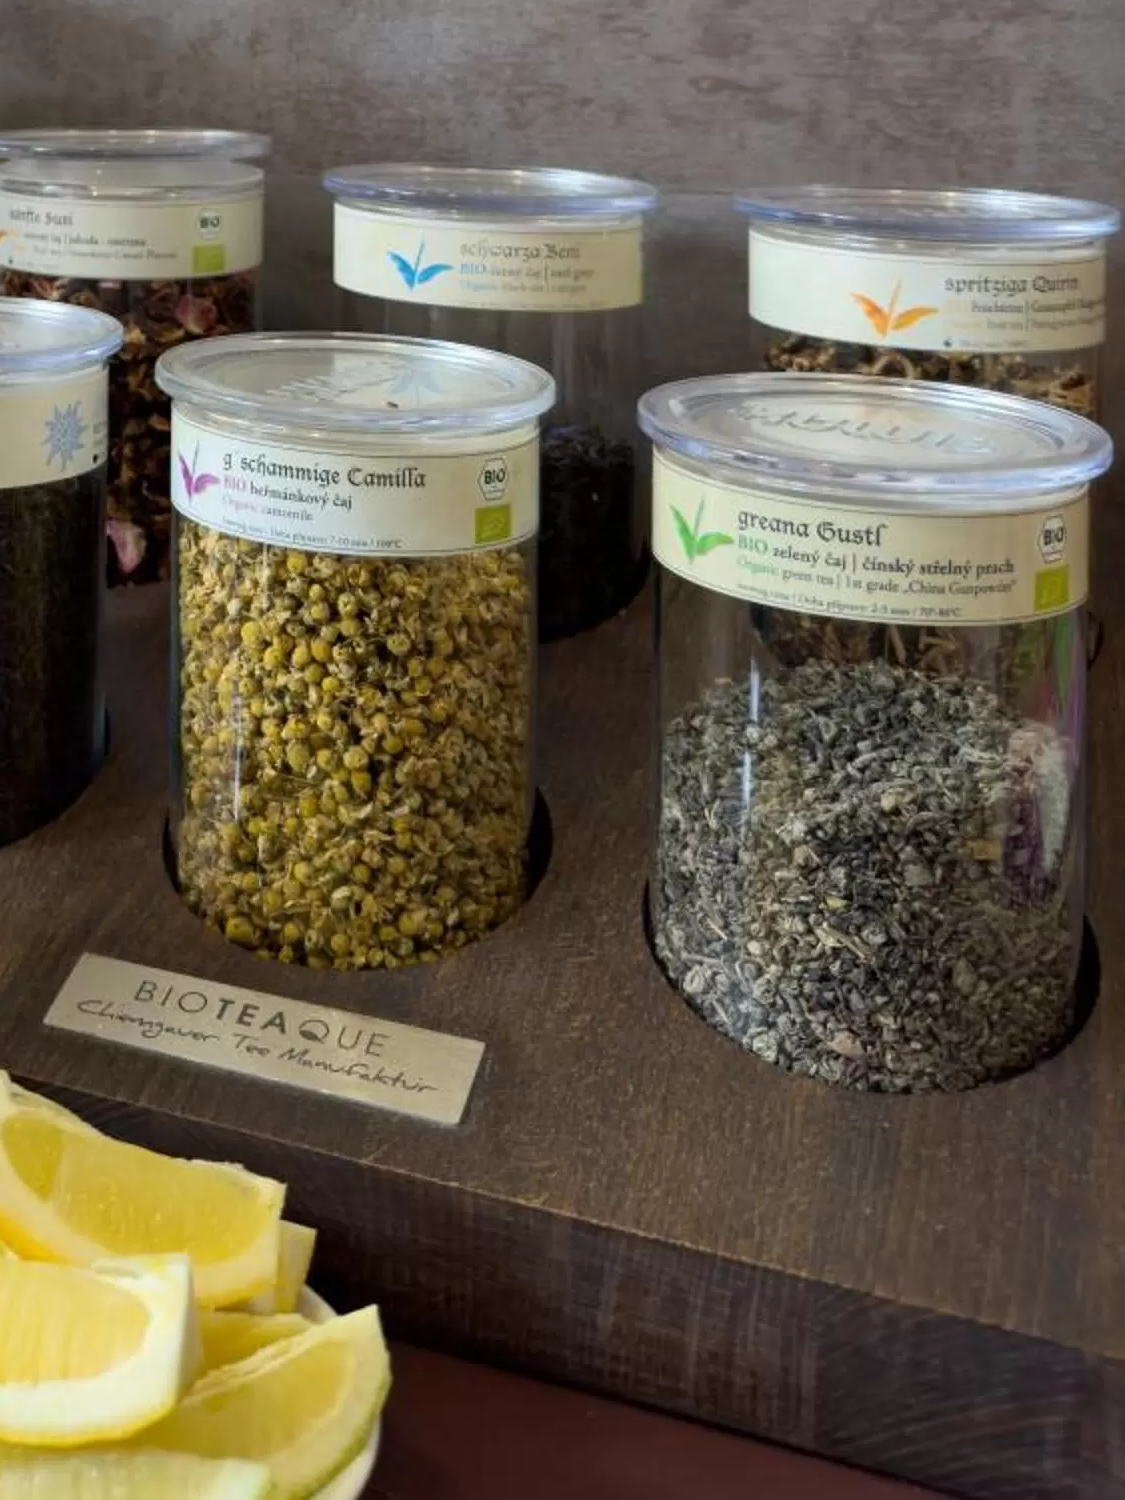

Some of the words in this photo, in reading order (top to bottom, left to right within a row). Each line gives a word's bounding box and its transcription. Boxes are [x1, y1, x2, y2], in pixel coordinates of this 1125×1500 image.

[483, 467, 506, 485] BIO
[738, 510, 810, 538] greana
[1042, 526, 1065, 546] BIO
[738, 533, 769, 555] BIO
[772, 545, 820, 568] zelený
[824, 551, 847, 572] čaj
[135, 979, 390, 1057] BIOTEAQUE
[231, 1031, 270, 1057] Tee
